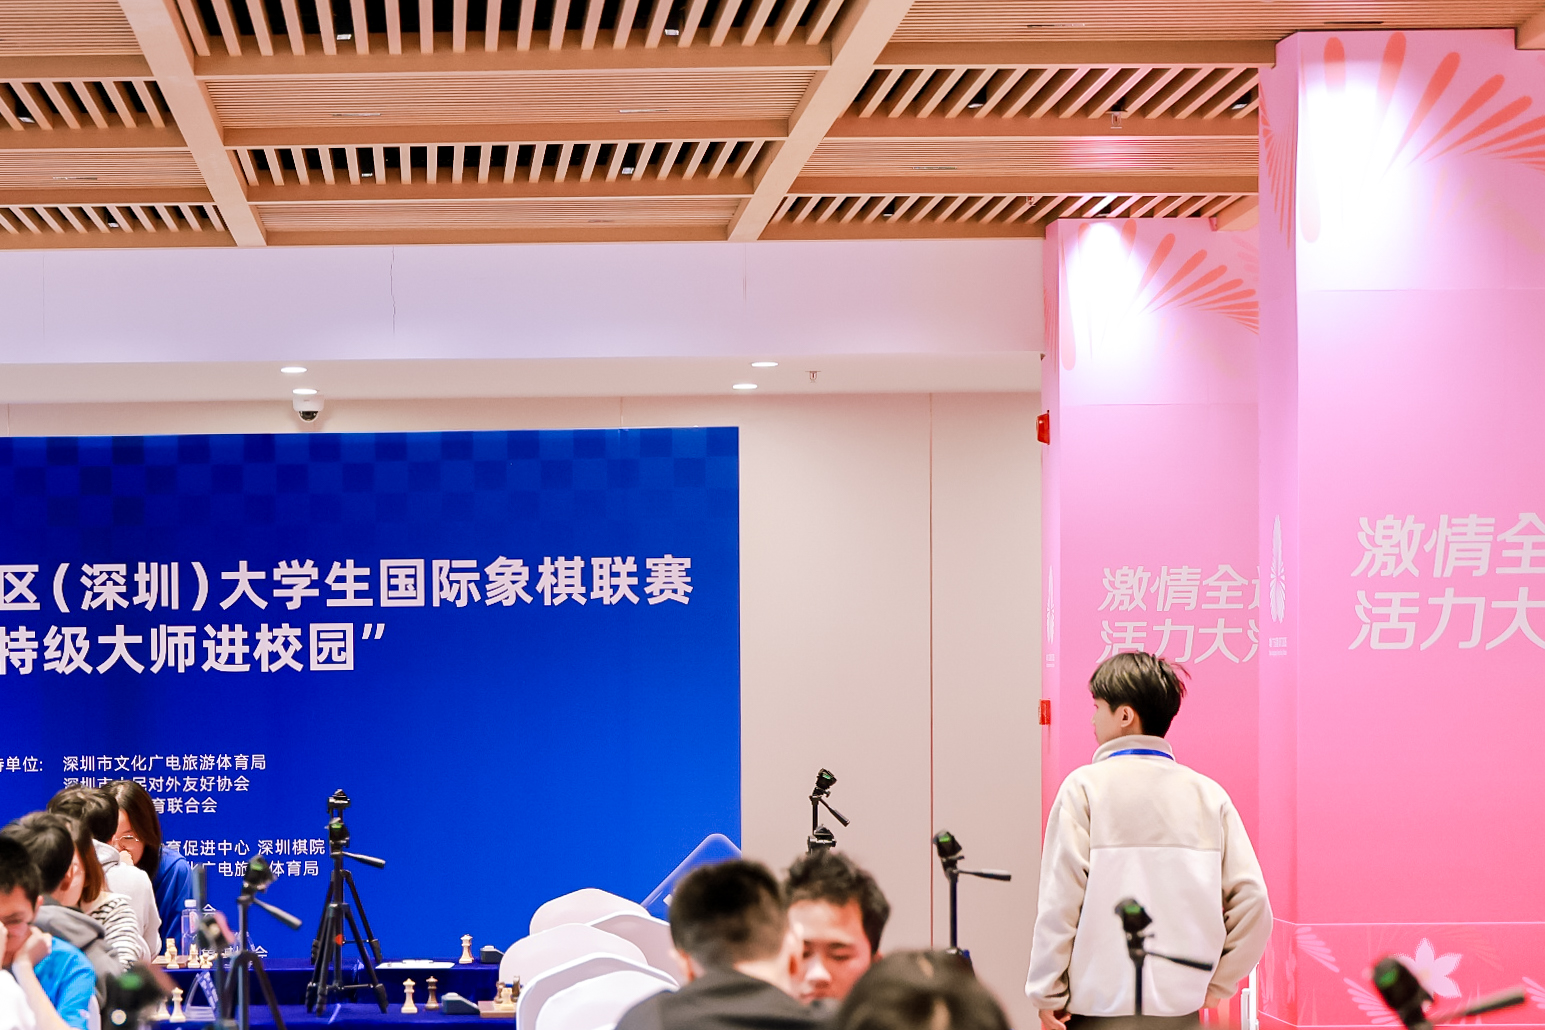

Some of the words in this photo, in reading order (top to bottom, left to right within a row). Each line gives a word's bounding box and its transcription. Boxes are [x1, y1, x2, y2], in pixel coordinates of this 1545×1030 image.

[1348, 586, 1545, 651] 活力大
[62, 754, 266, 772] 深圳市文化广电旅游体育局
[257, 838, 326, 856] 深圳棋院
